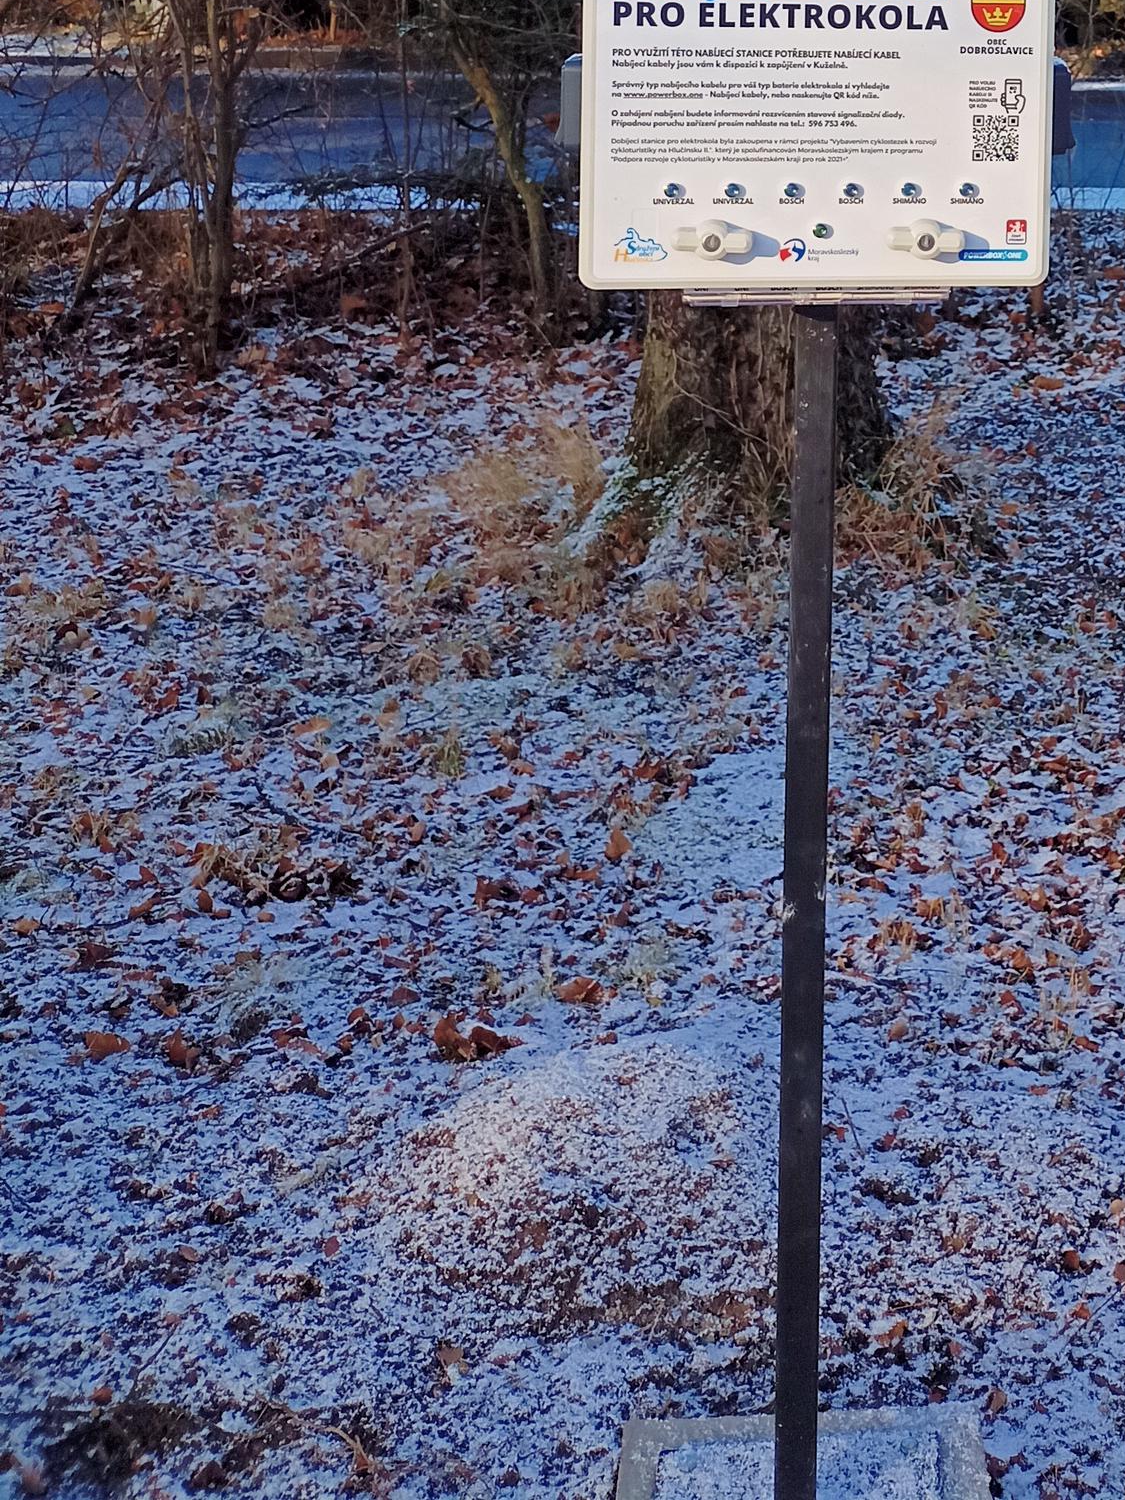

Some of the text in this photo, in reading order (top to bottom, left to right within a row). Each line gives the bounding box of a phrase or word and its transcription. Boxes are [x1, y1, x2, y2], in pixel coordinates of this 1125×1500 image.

[613, 1, 949, 31] PRO ELEKTROKOLA
[986, 38, 1007, 46] OBEC
[612, 46, 901, 59] PRO VYUŽITÍ TÉTO NABÍJECÍ STANICE POTŘEBUJETE NABÍJECÍ KABEL
[960, 46, 1034, 55] DOBROSLAVICE
[612, 60, 646, 70] Nabíjecí
[647, 60, 675, 70] kabely
[676, 60, 695, 70] jsou
[696, 60, 714, 68] vám
[722, 60, 758, 71] dispozici
[767, 61, 805, 71] zapůjčení
[612, 80, 645, 91] Správný
[646, 80, 659, 91] typ
[728, 83, 742, 91] pro
[743, 81, 757, 89] váš
[758, 81, 770, 91] typ
[772, 81, 799, 89] baterie
[800, 81, 843, 89] elektrokola
[851, 82, 890, 92] vyhledejte
[623, 90, 703, 100] www.powerbox.one
[710, 91, 740, 101] Nabíjecí
[791, 91, 832, 101] naskenujte
[846, 91, 861, 99] kód
[862, 91, 879, 99] níže.
[620, 110, 653, 120] zahájení
[654, 110, 685, 120] nabíjení
[807, 110, 836, 118] stavové
[882, 111, 905, 120] diody.
[653, 120, 685, 129] poruchu
[717, 120, 744, 129] prosím
[666, 139, 679, 147] pro
[720, 138, 734, 147] byla
[735, 138, 773, 147] zakoupena
[800, 138, 829, 147] projektu
[611, 147, 656, 155] cykloturistiky
[860, 147, 883, 156] krajem
[644, 156, 669, 164] rozvoje
[670, 156, 715, 164] cykloturistiky
[786, 156, 801, 164] kraji
[653, 197, 695, 205] UNIVERZAL
[712, 197, 754, 205] UNIVERZAL
